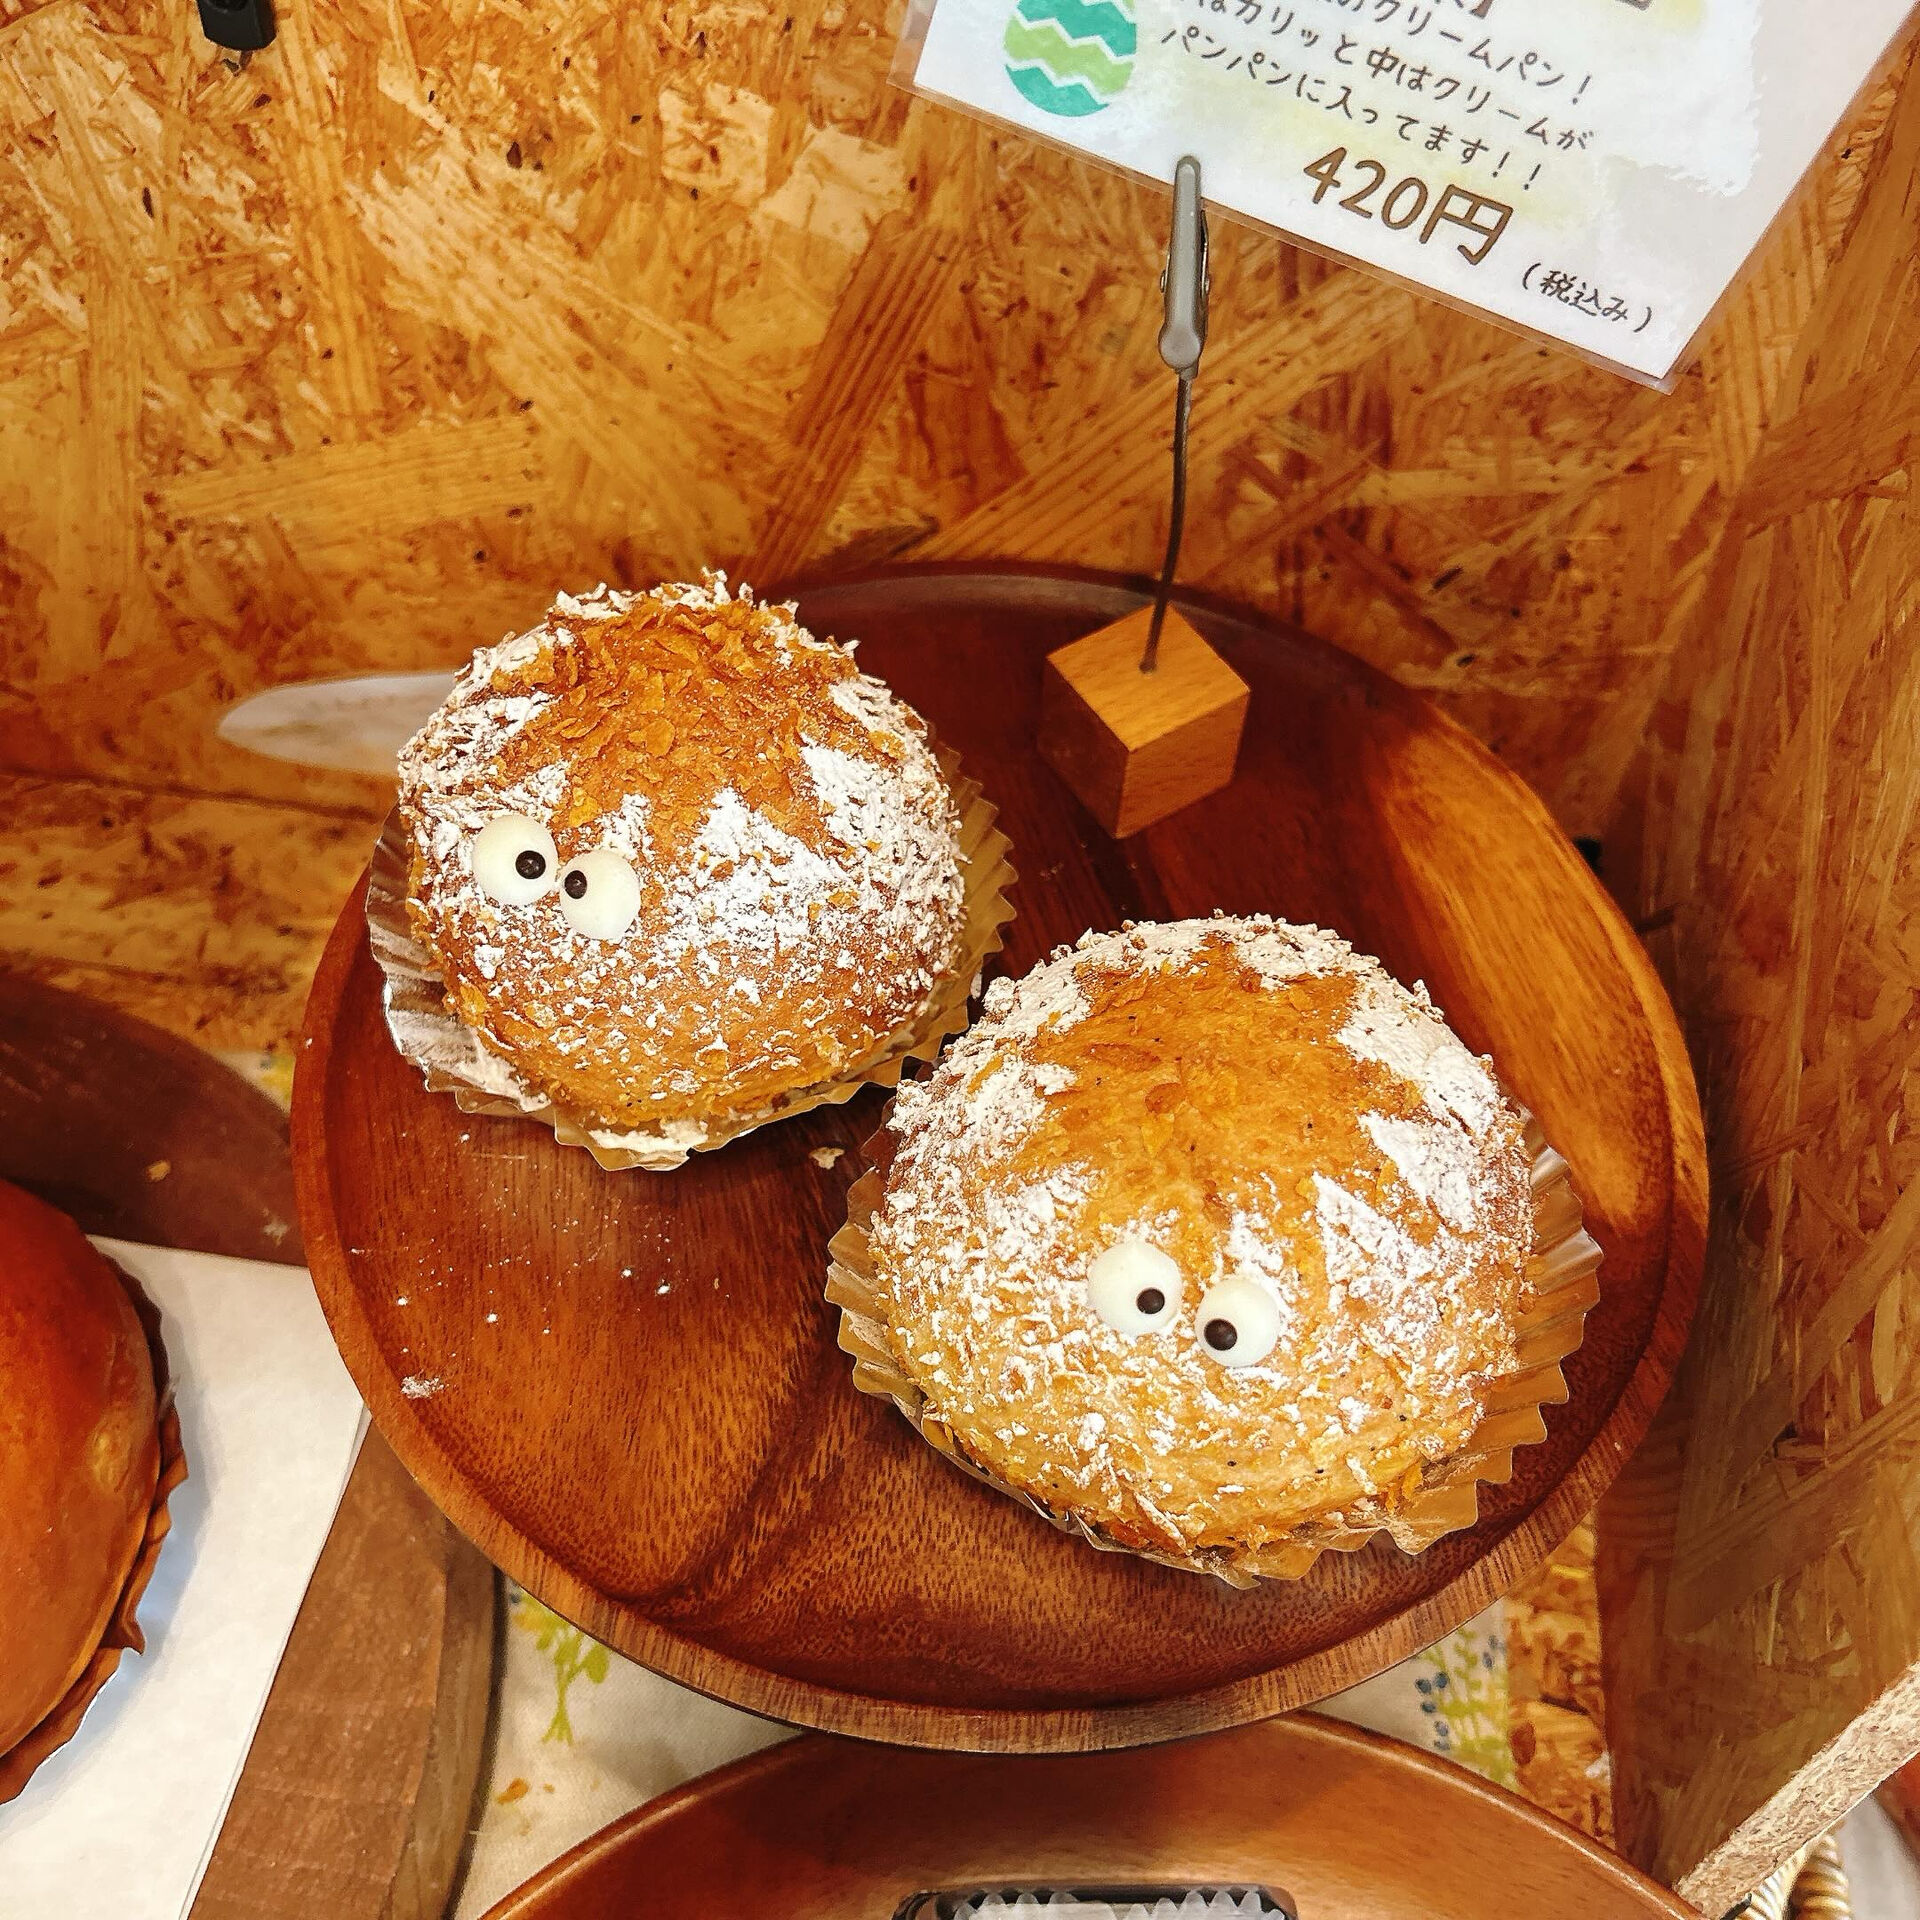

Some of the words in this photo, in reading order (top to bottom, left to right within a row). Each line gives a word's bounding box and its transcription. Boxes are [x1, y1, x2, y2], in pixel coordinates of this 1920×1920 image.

[1303, 146, 1514, 266] 420円
[1522, 262, 1653, 333] （税込み）
